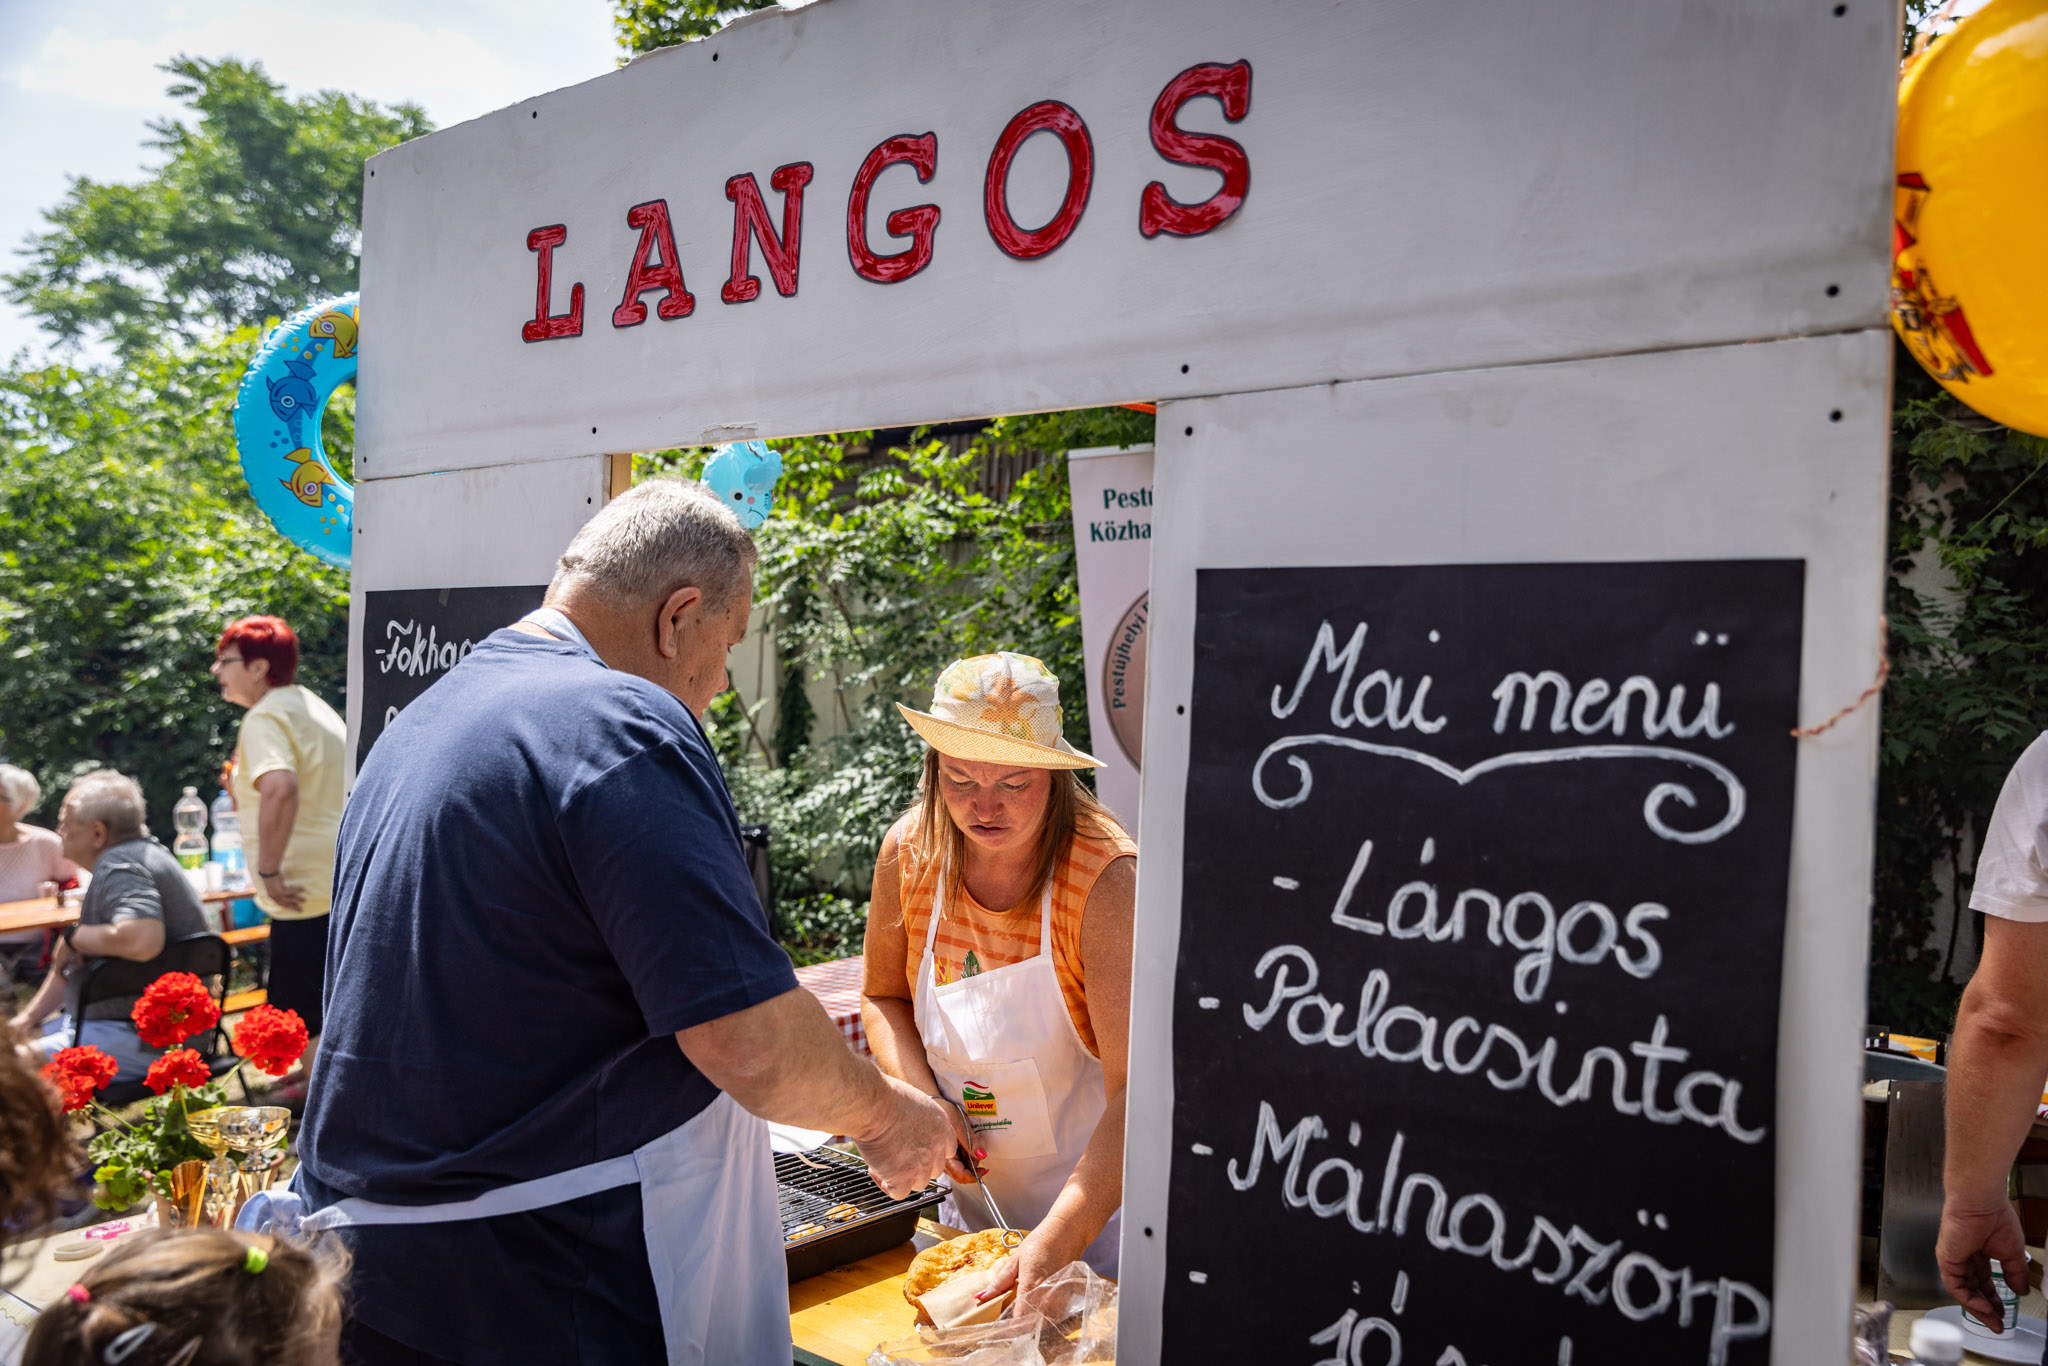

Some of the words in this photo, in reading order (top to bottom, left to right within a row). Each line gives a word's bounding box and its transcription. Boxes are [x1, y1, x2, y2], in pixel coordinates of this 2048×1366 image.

[522, 58, 1252, 344] LANGOS
[1112, 612, 1146, 709] Pestújhelyi
[1271, 619, 1447, 734] Mai
[1492, 630, 1735, 739] menü
[1331, 838, 1670, 1001] Lángos
[1242, 945, 1766, 1143] Palacsinta
[1227, 1100, 1771, 1366] Málnaszörp
